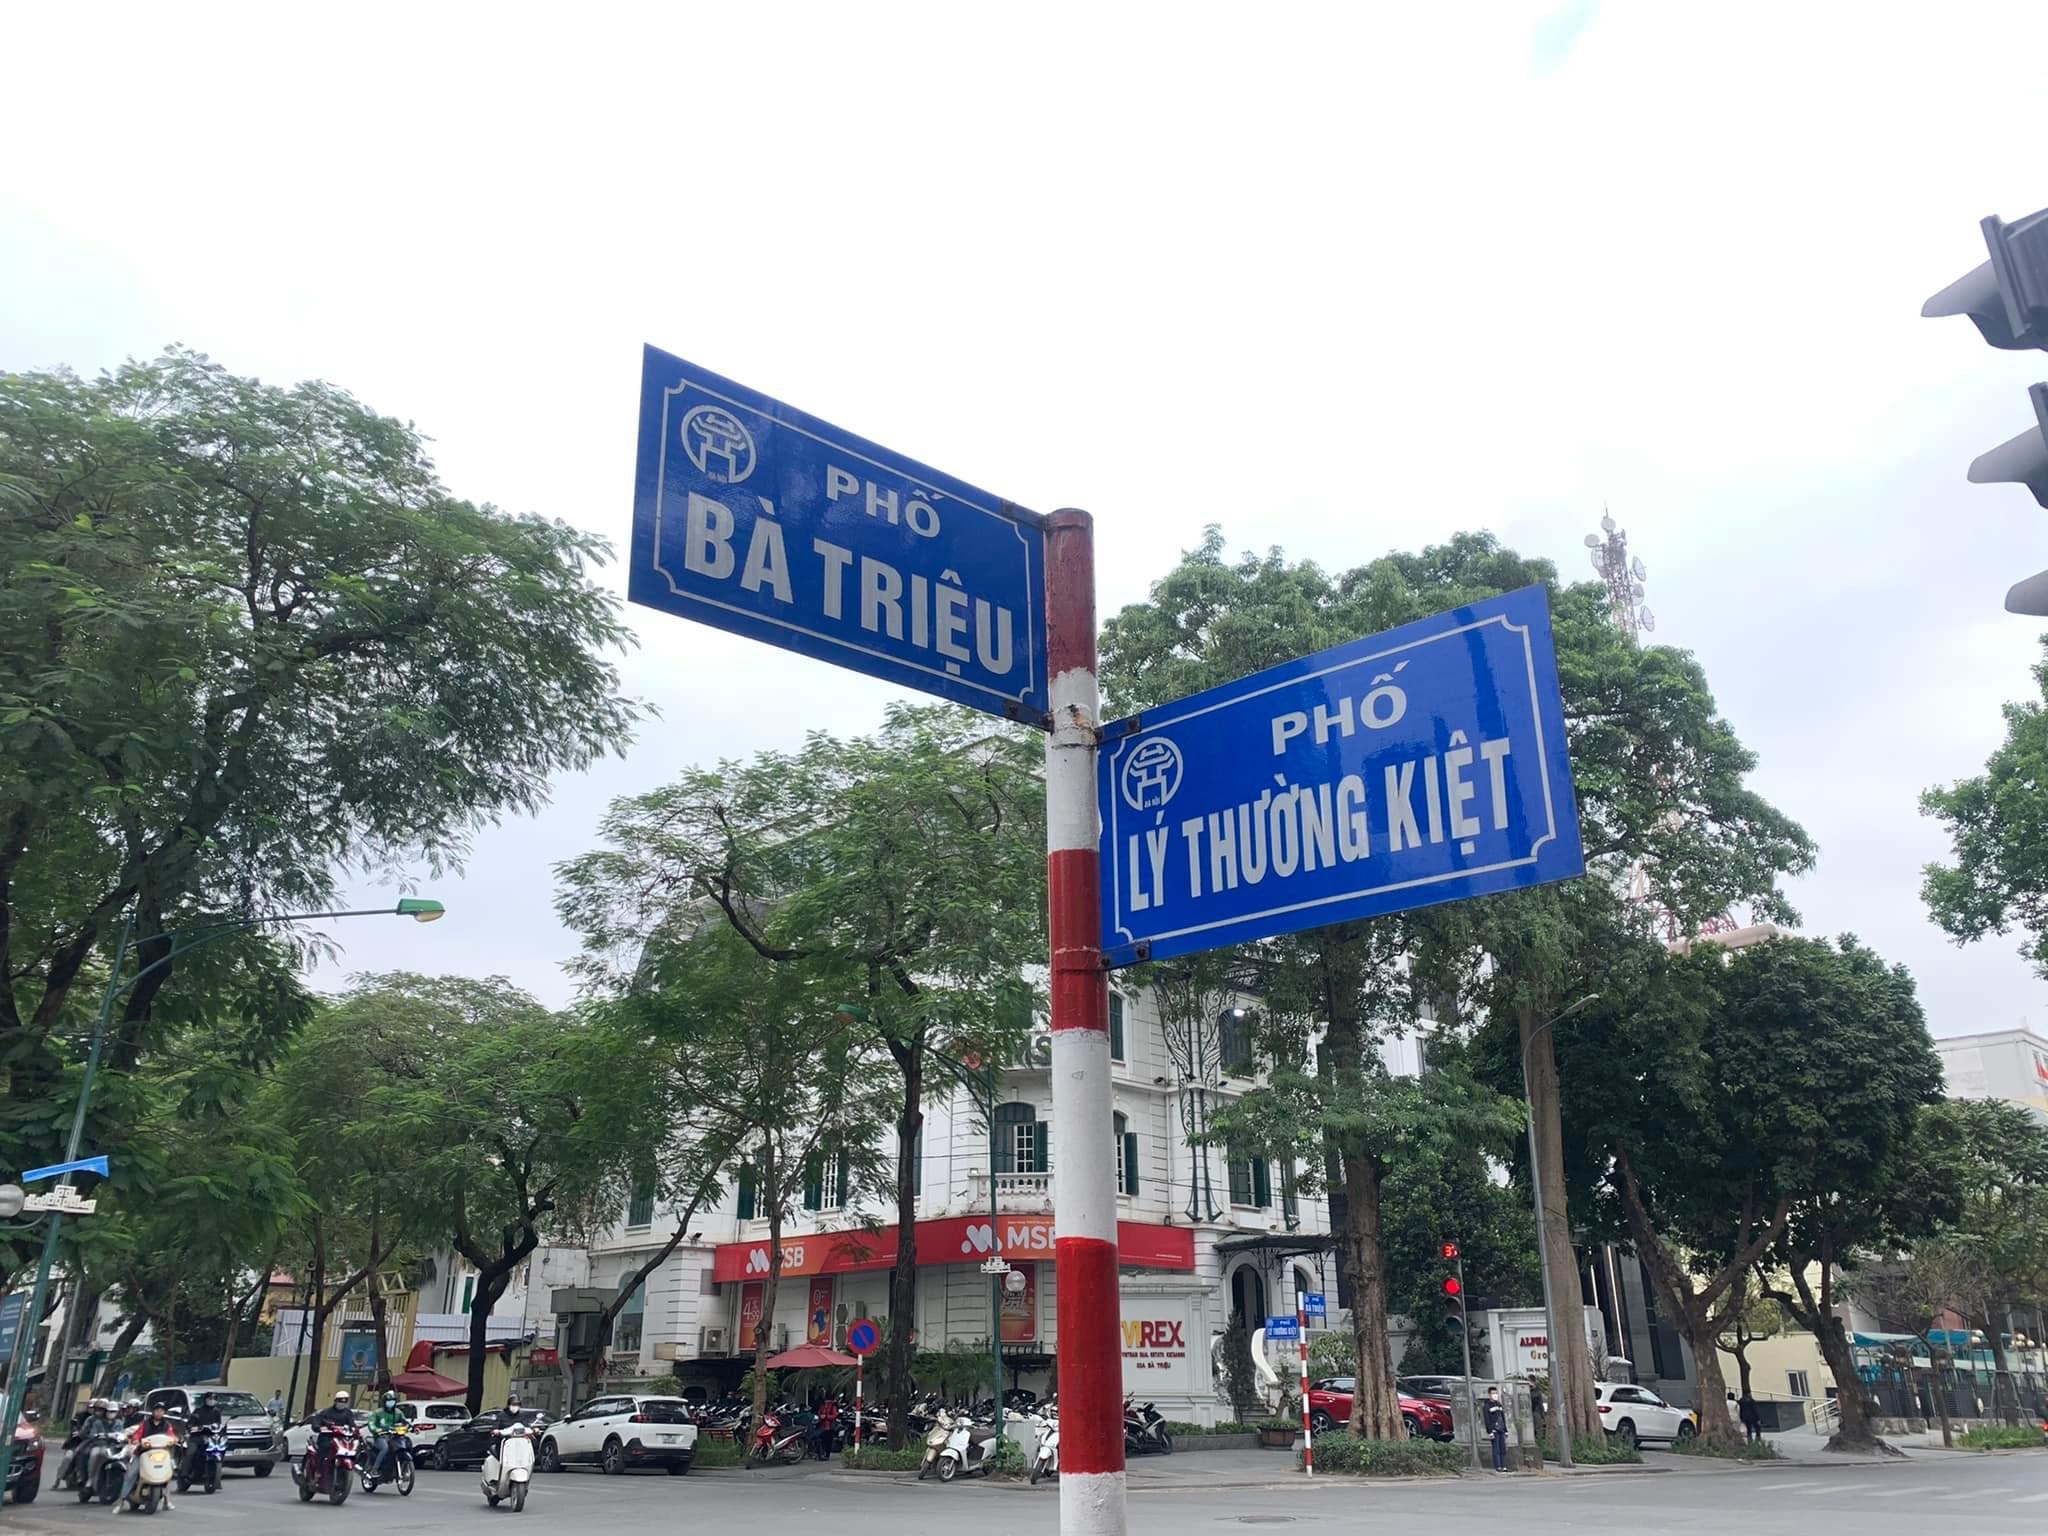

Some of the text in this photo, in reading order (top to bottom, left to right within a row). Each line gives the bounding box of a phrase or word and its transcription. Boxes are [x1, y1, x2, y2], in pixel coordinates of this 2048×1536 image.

[826, 463, 945, 538] PHỐ
[684, 490, 1013, 676] BÀ TRIỆU
[1271, 659, 1410, 756] PHỐ
[1128, 729, 1511, 912] LÝ THƯỜNG KIỆT
